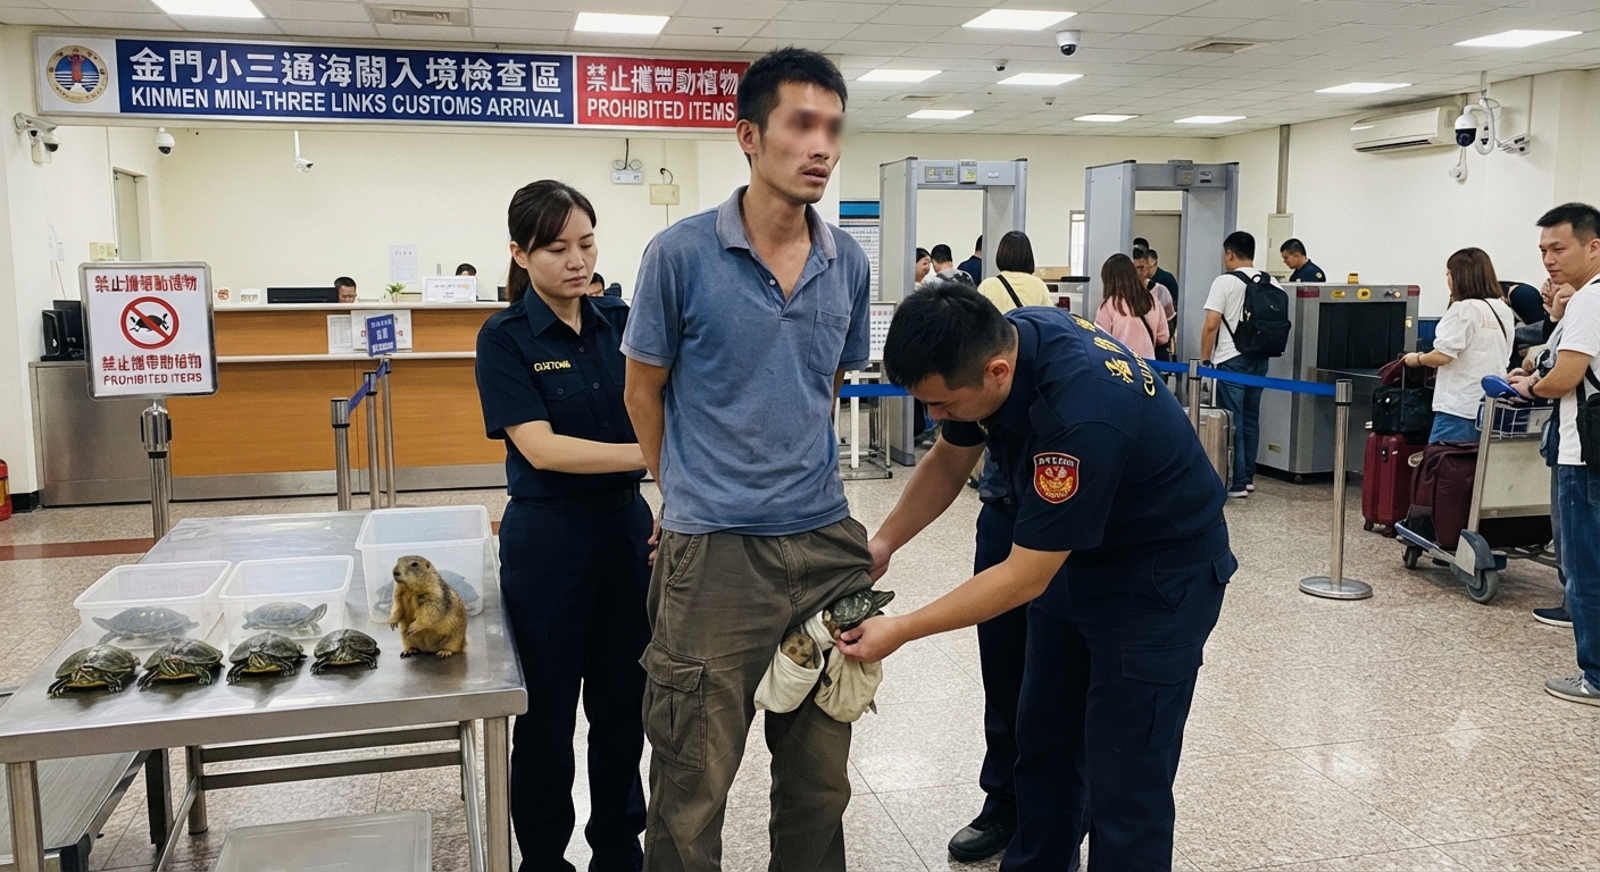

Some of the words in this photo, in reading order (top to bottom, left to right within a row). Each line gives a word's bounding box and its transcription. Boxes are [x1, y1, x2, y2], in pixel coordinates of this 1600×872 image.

[131, 86, 209, 109] KINMEN
[215, 89, 326, 112] MINI-THREE
[331, 92, 387, 113] LINKS
[391, 94, 483, 116] CUSTOMS
[486, 97, 565, 118] ARRIVAL
[587, 98, 685, 120] PROHIBITED
[688, 102, 736, 122] ITEMS
